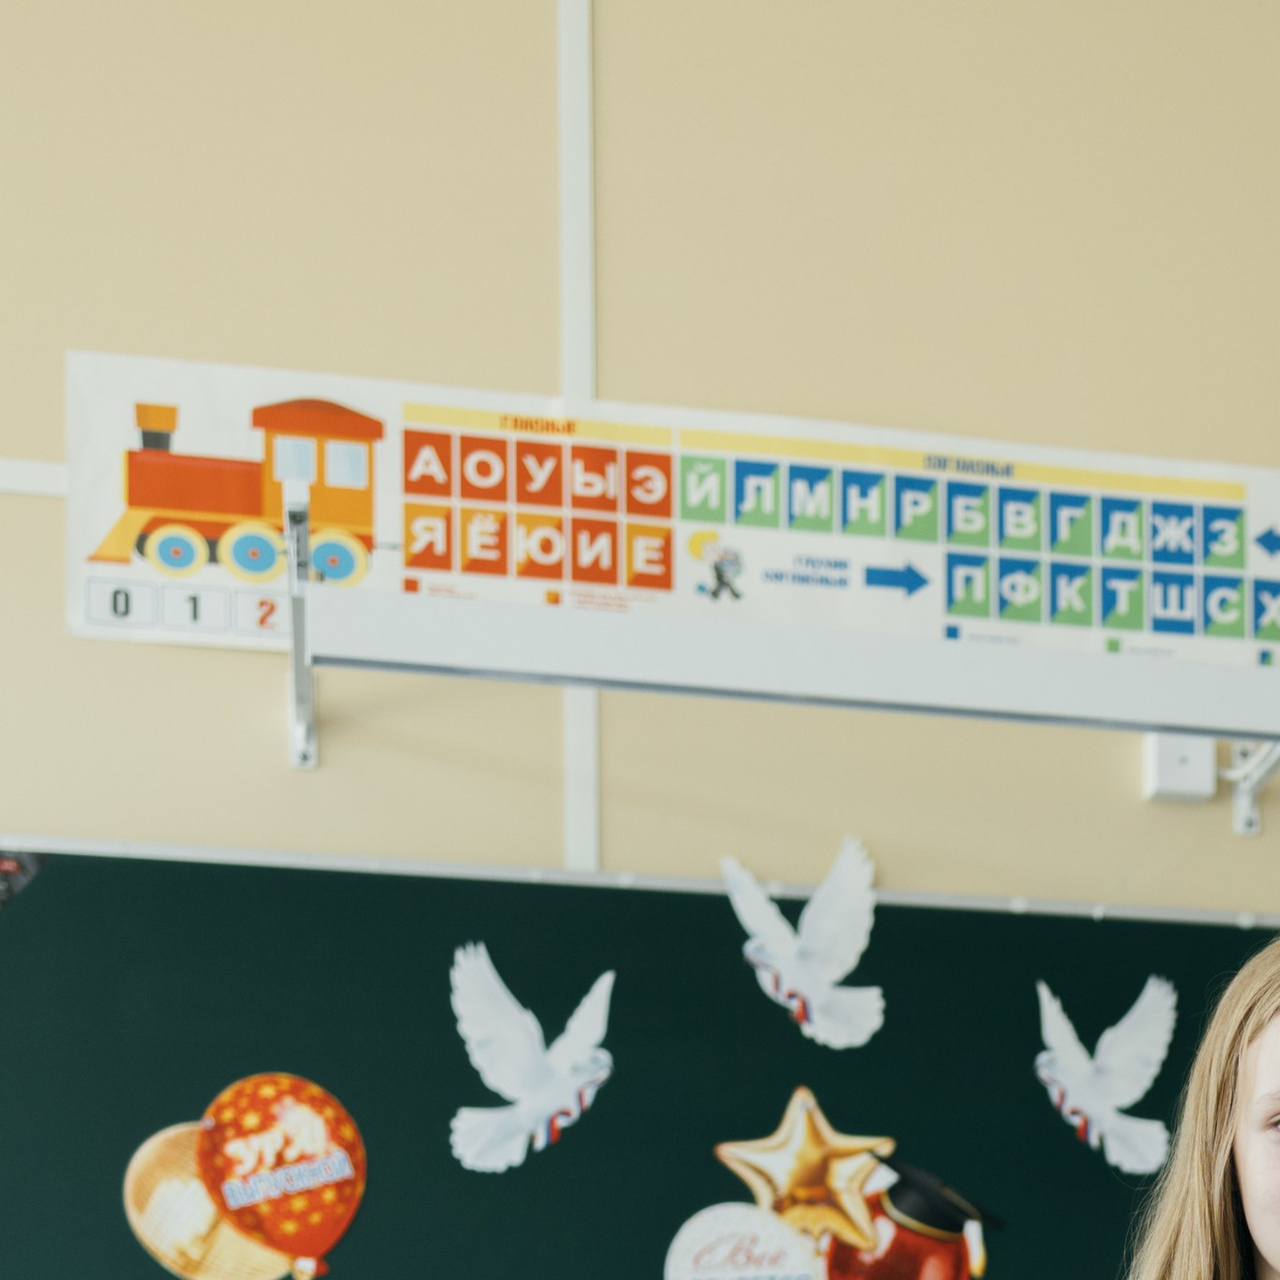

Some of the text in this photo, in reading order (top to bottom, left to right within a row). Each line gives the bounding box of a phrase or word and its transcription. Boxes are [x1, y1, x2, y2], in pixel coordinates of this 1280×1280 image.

[408, 445, 667, 504] А О У Ы Э
[686, 462, 1240, 556] Й Л М Н Р Б В Г Д Ж З
[408, 513, 667, 575] Я Ё Ю И Е
[111, 589, 276, 629] 0 1 2
[953, 564, 986, 604] П
[1000, 569, 1040, 607] Ф
[1056, 574, 1087, 613] К
[1105, 578, 1139, 617] Т
[1152, 583, 1195, 621] Ш
[1205, 585, 1242, 625] С
